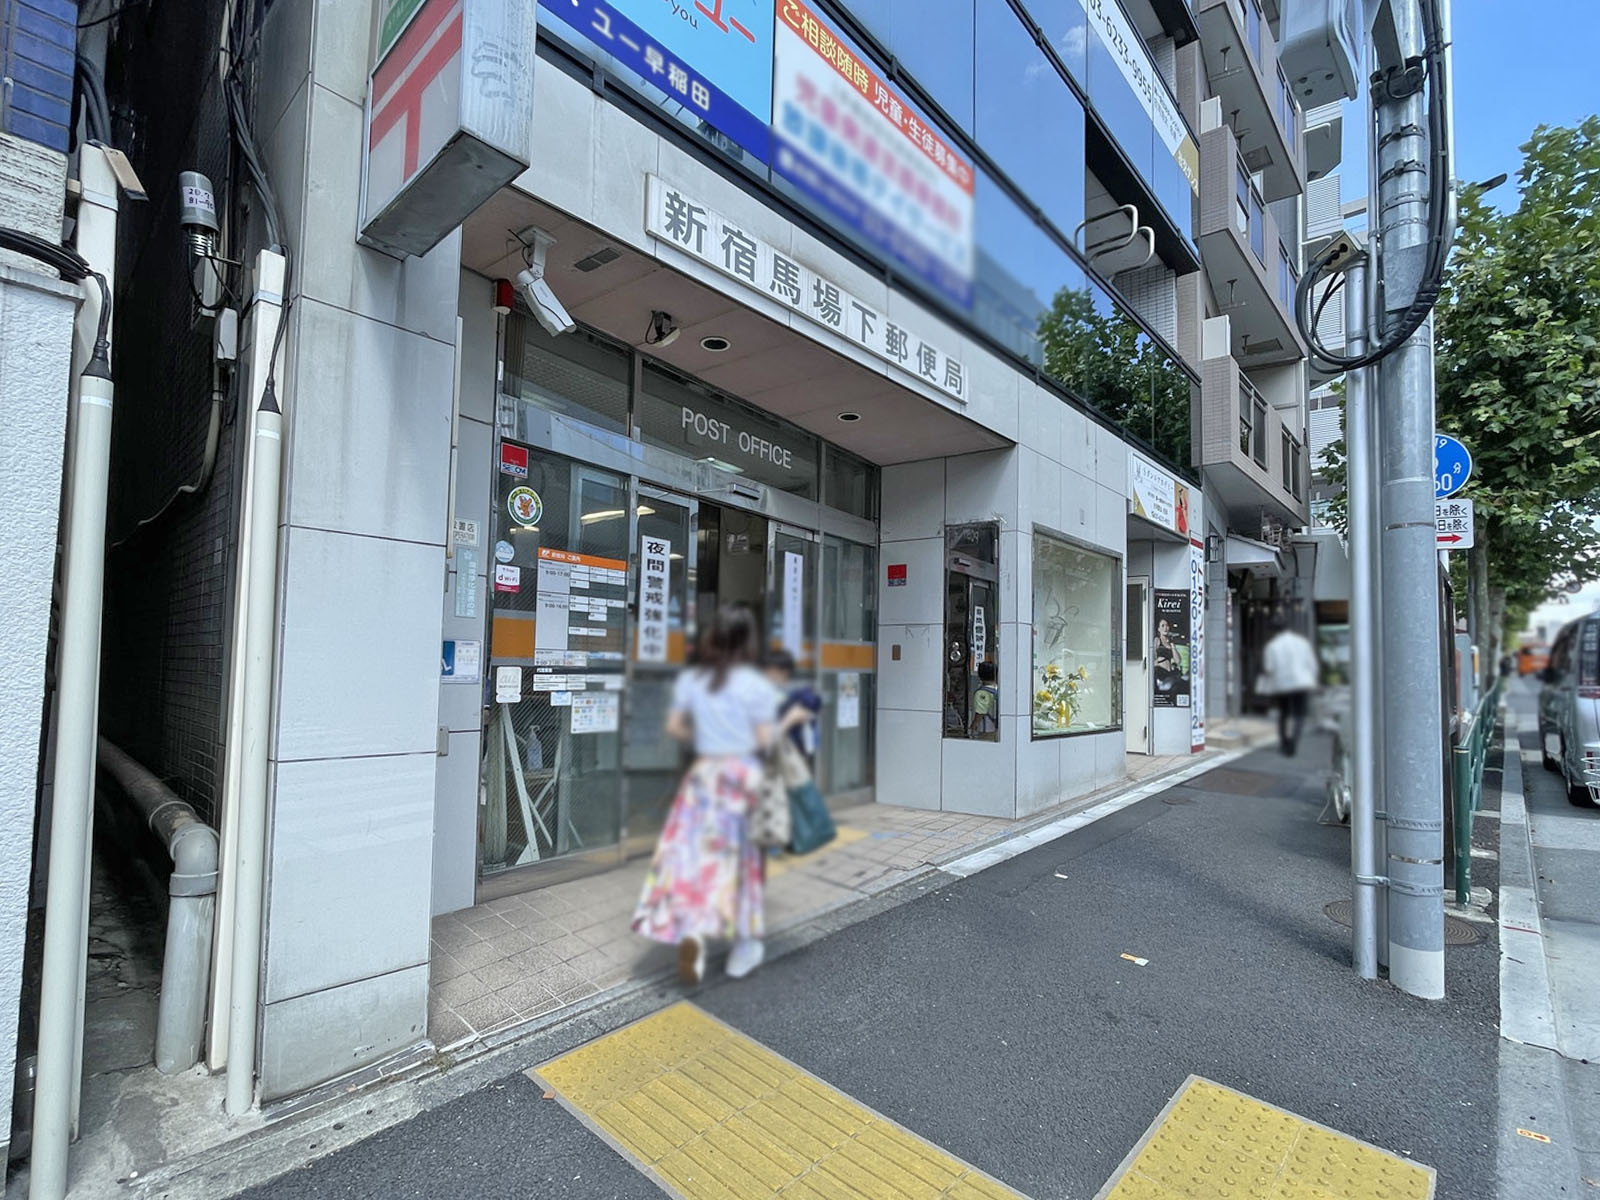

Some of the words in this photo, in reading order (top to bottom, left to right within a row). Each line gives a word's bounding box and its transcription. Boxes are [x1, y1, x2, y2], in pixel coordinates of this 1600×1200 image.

[571, 0, 711, 112] ユー早稲田
[783, 0, 870, 95] ご相談随時
[664, 191, 965, 396] 新宿馬場下郵便局
[681, 406, 730, 445] POST
[738, 431, 793, 470] OFFICE
[1453, 462, 1462, 474] 分
[1435, 519, 1468, 532] 日を除く
